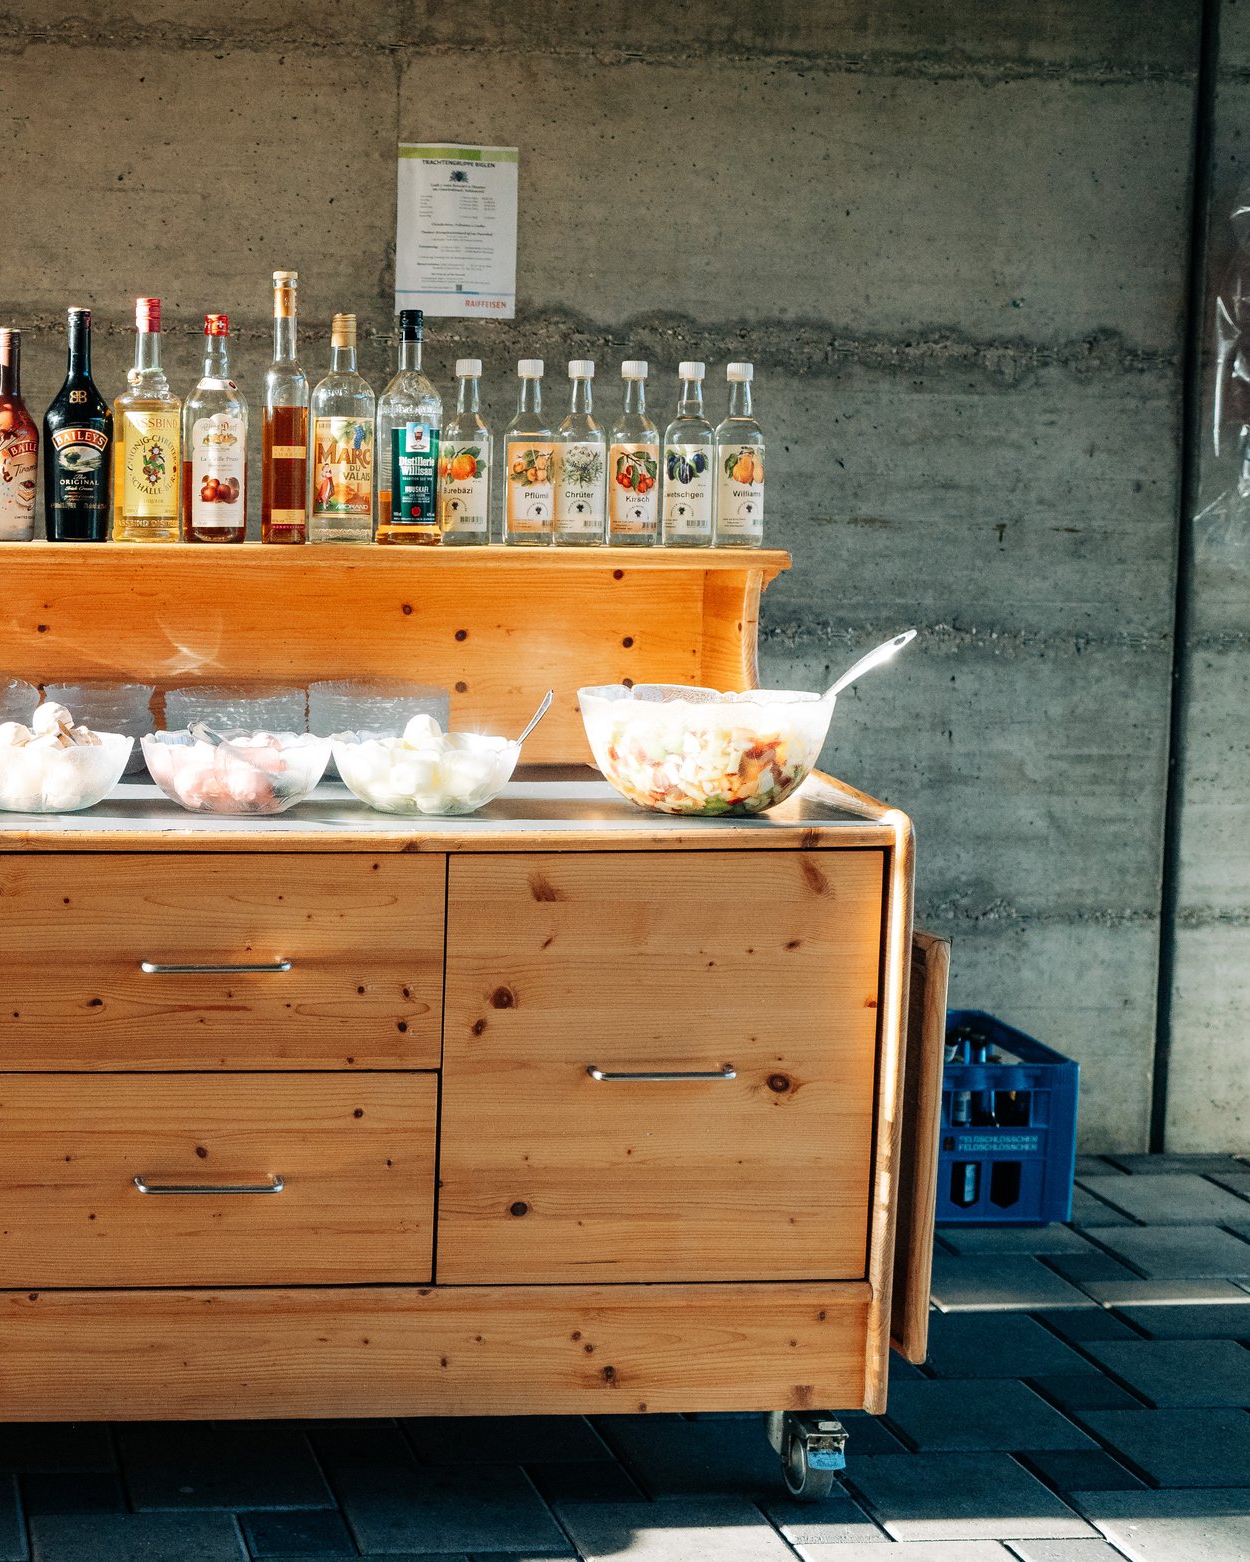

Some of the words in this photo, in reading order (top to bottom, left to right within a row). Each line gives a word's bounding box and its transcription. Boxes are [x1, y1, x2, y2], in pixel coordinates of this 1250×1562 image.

[464, 299, 507, 309] RAIFFEISEN
[128, 417, 178, 429] FASSBIND
[55, 430, 106, 446] BAILEYS
[317, 441, 371, 469] MARC
[398, 456, 435, 467] Distillerie
[349, 464, 361, 472] DU
[400, 466, 433, 476] Willisau
[343, 471, 371, 481] VALAIS
[564, 490, 594, 499] Chrüter
[625, 495, 650, 503] Kirsch
[665, 490, 704, 499] wetschgen
[732, 490, 762, 498] Williams
